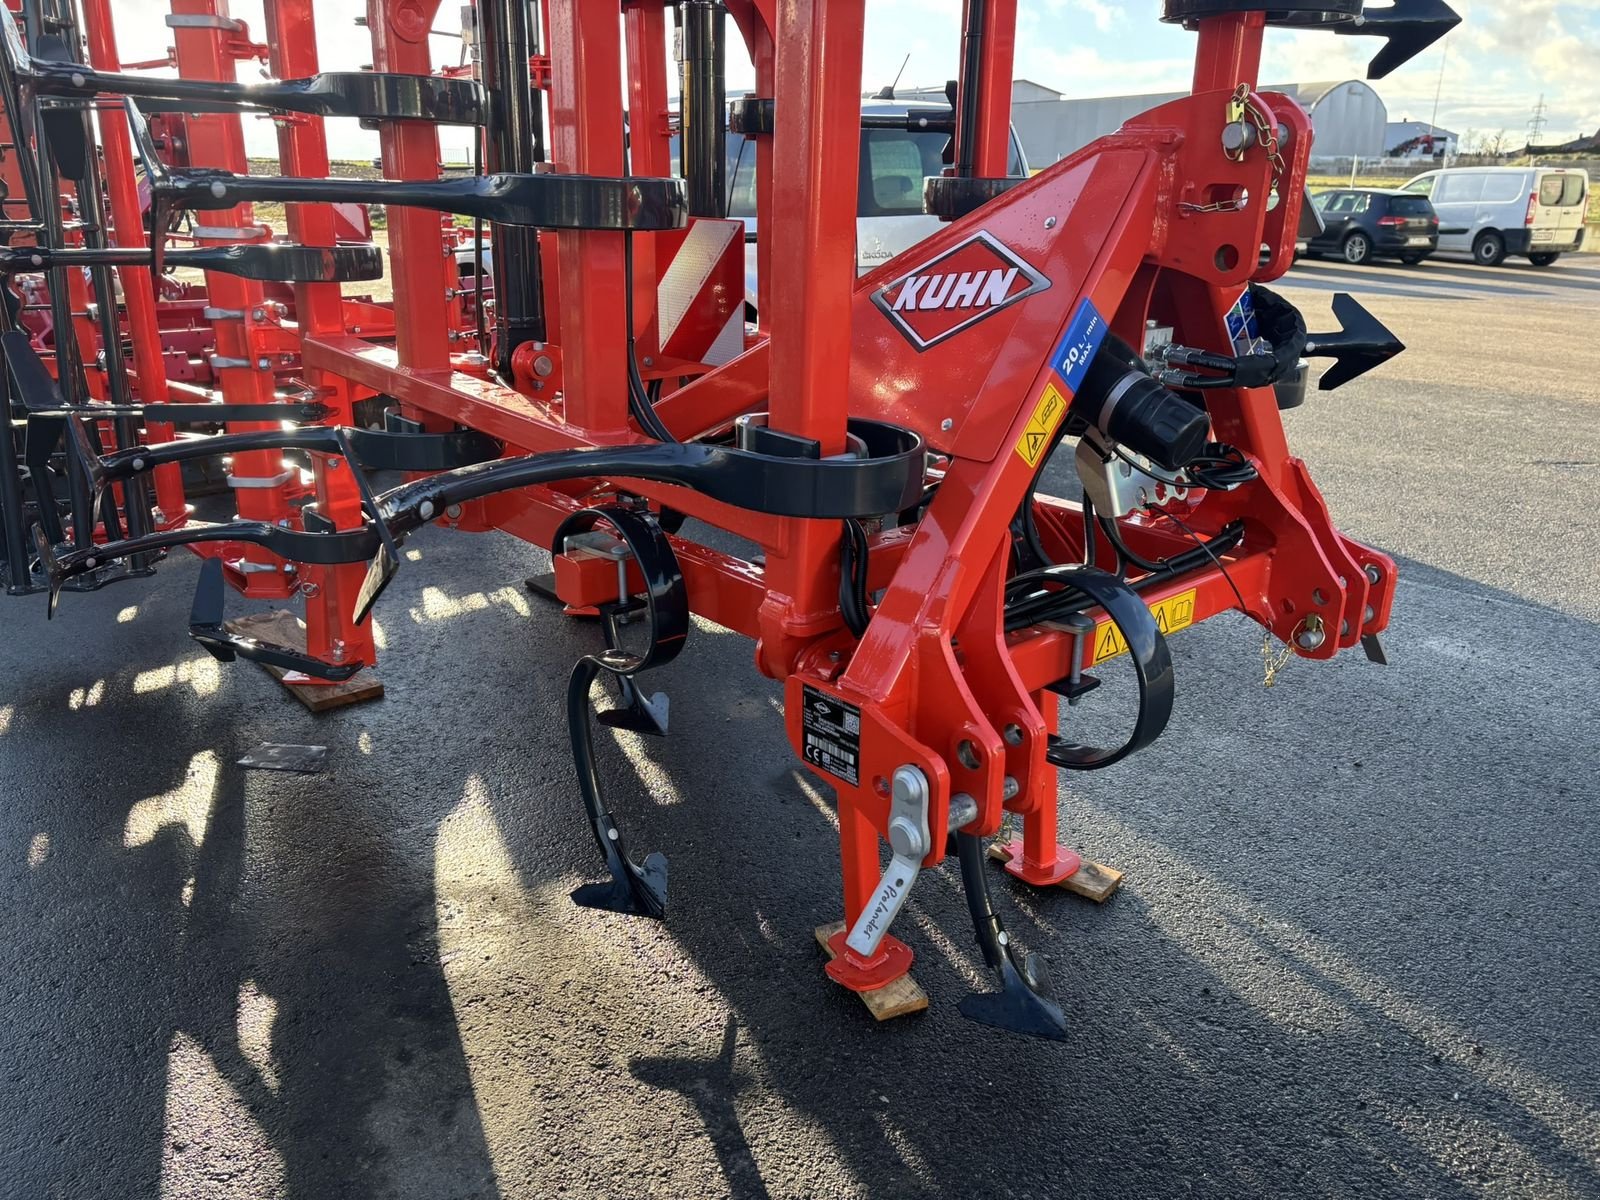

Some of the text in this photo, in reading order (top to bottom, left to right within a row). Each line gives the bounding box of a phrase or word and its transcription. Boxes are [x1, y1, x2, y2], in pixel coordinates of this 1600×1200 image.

[892, 267, 1019, 311] KUHN
[1062, 347, 1079, 376] 20
[1086, 316, 1098, 335] min
[1078, 342, 1093, 366] MAX
[806, 745, 819, 761] CE
